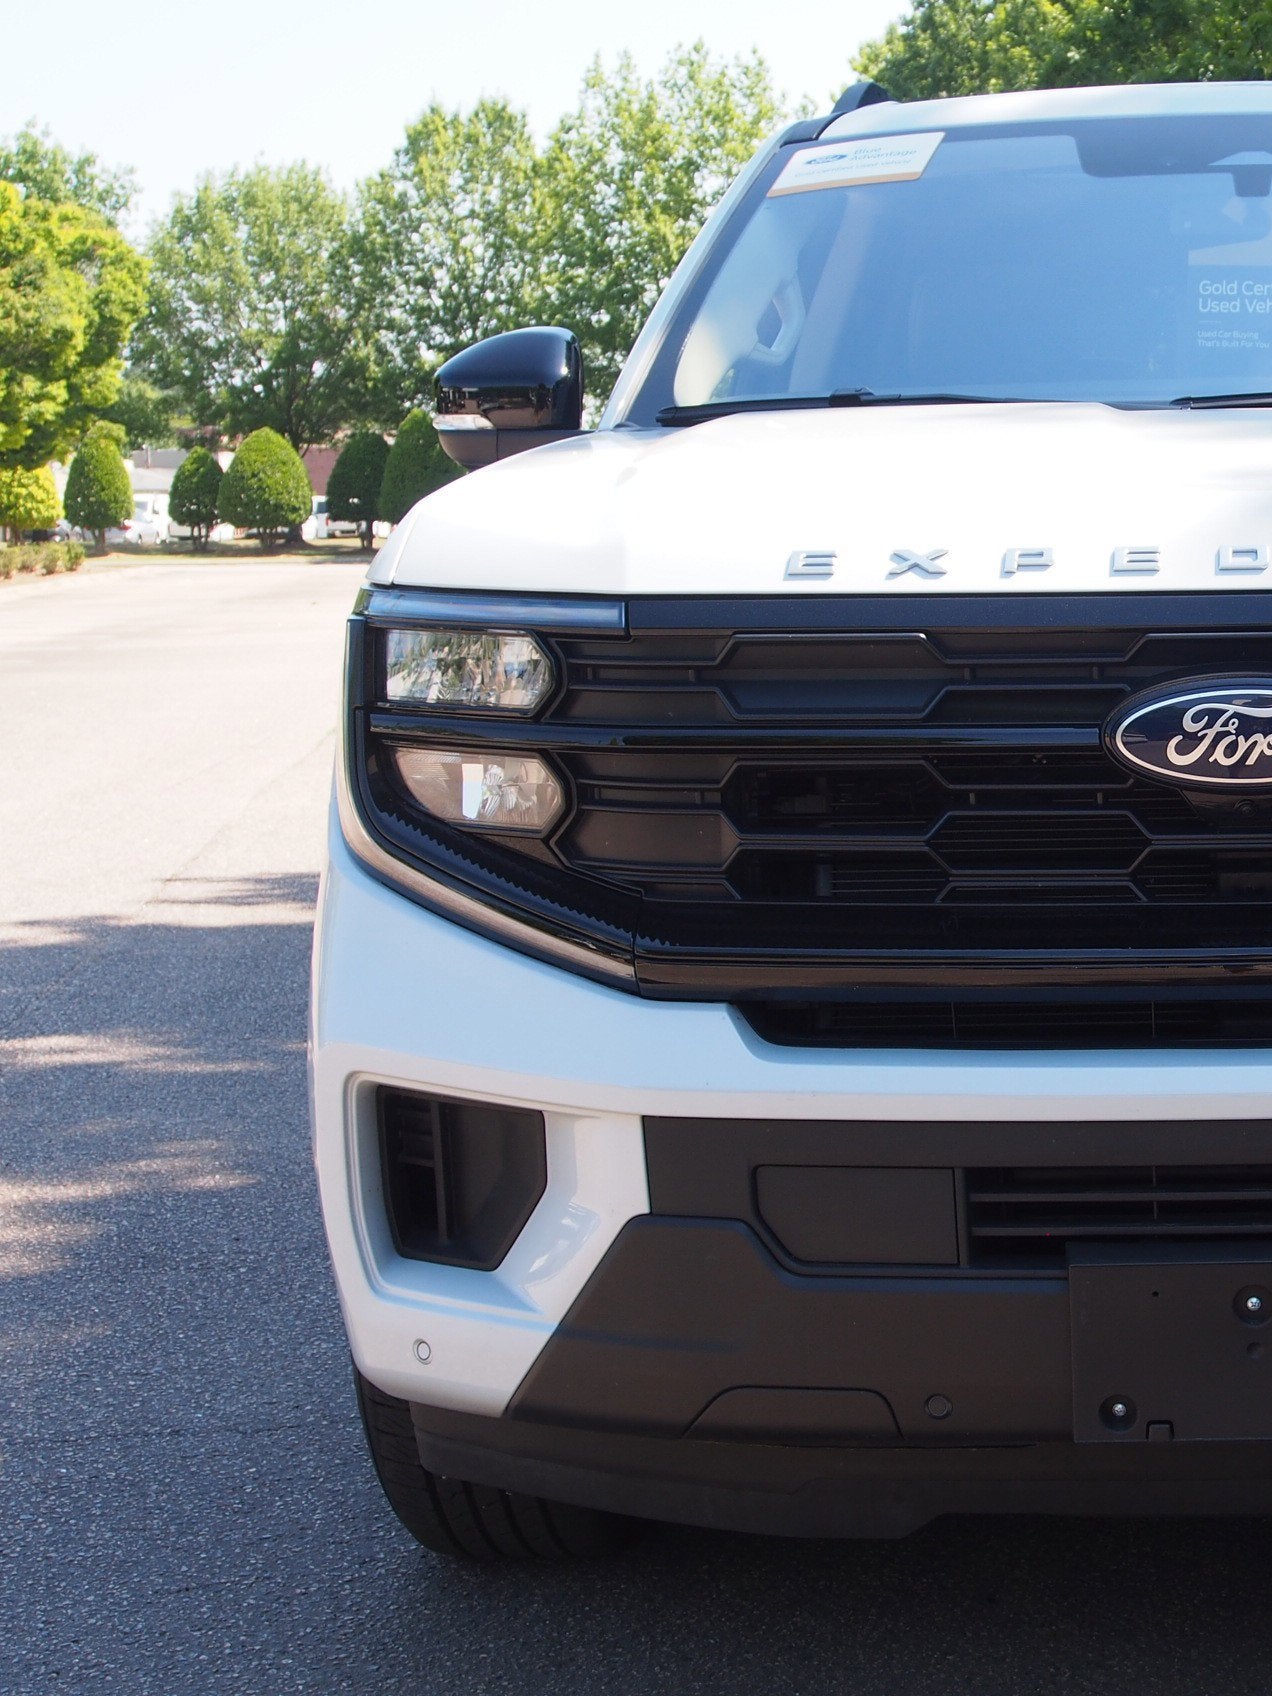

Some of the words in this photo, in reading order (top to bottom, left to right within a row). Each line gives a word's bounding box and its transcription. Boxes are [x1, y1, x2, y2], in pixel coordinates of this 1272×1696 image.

[1199, 280, 1238, 295] Gold
[1199, 298, 1240, 313] Used
[1197, 330, 1217, 338] Used
[1218, 330, 1232, 338] Car
[1233, 330, 1259, 340] Buying
[1198, 339, 1220, 347] That's
[1255, 341, 1271, 349] You
